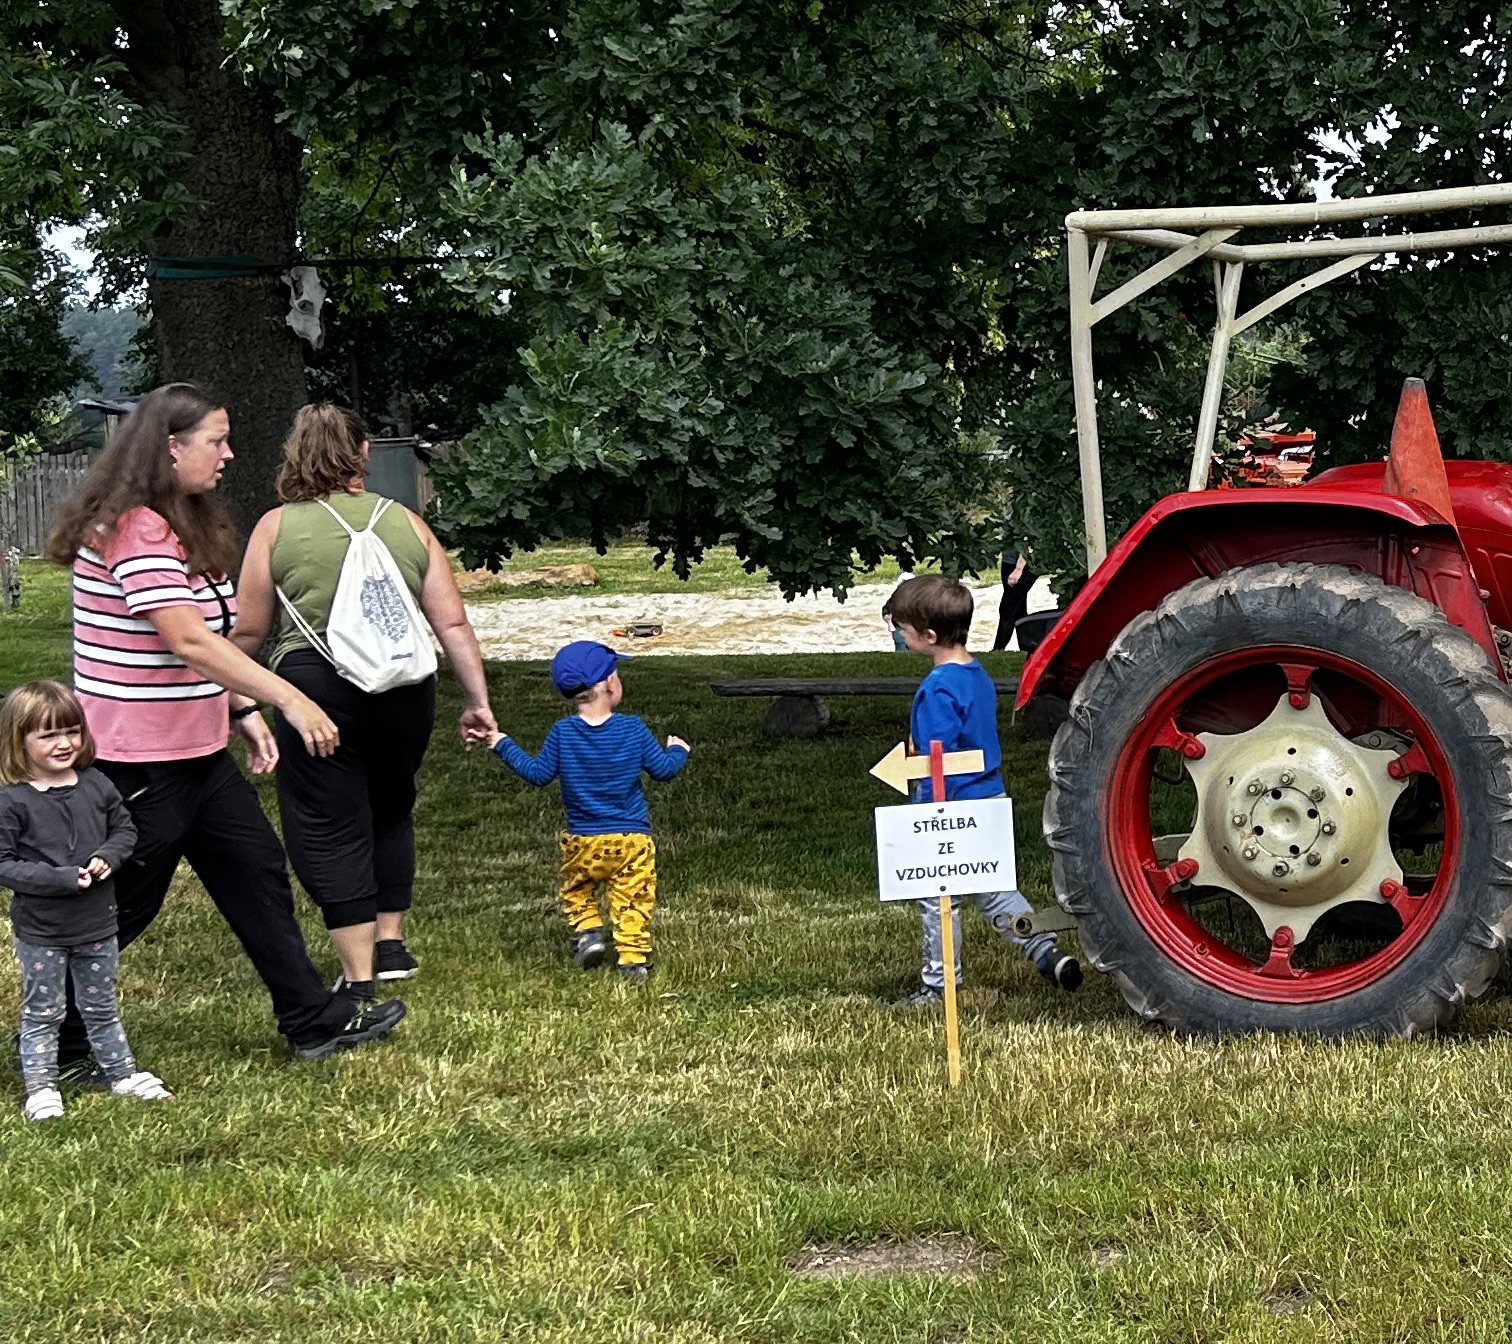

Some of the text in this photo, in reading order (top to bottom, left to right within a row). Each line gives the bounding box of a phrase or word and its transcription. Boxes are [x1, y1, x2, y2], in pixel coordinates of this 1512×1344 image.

[912, 816, 978, 834] STŘELBA
[937, 841, 956, 855] ZE
[895, 860, 1000, 881] VZDUCHOVKY
